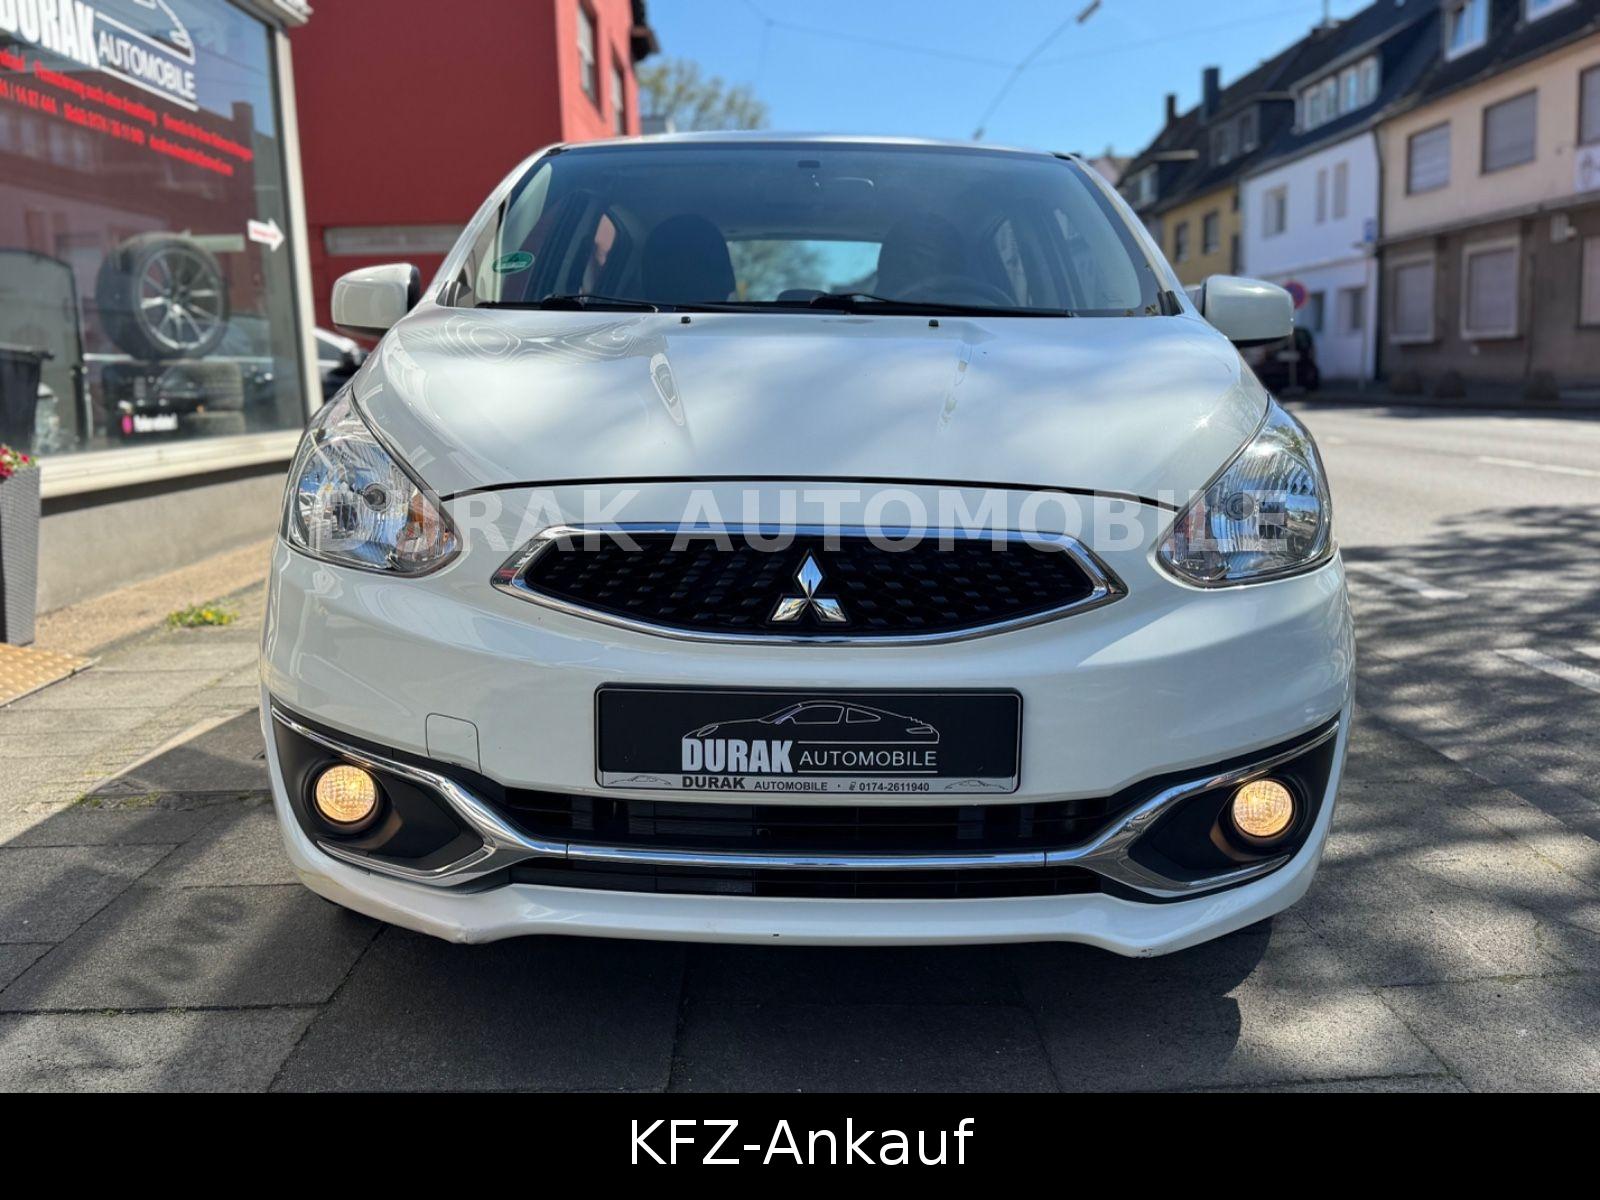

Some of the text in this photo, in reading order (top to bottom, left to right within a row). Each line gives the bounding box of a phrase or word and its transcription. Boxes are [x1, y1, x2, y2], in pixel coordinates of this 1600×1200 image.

[98, 30, 197, 100] AUTOMOBILE
[681, 738, 938, 773] DURAK AUTOMOBILE
[681, 776, 930, 792] DURAK AUTOMOBILE 0174-2611940
